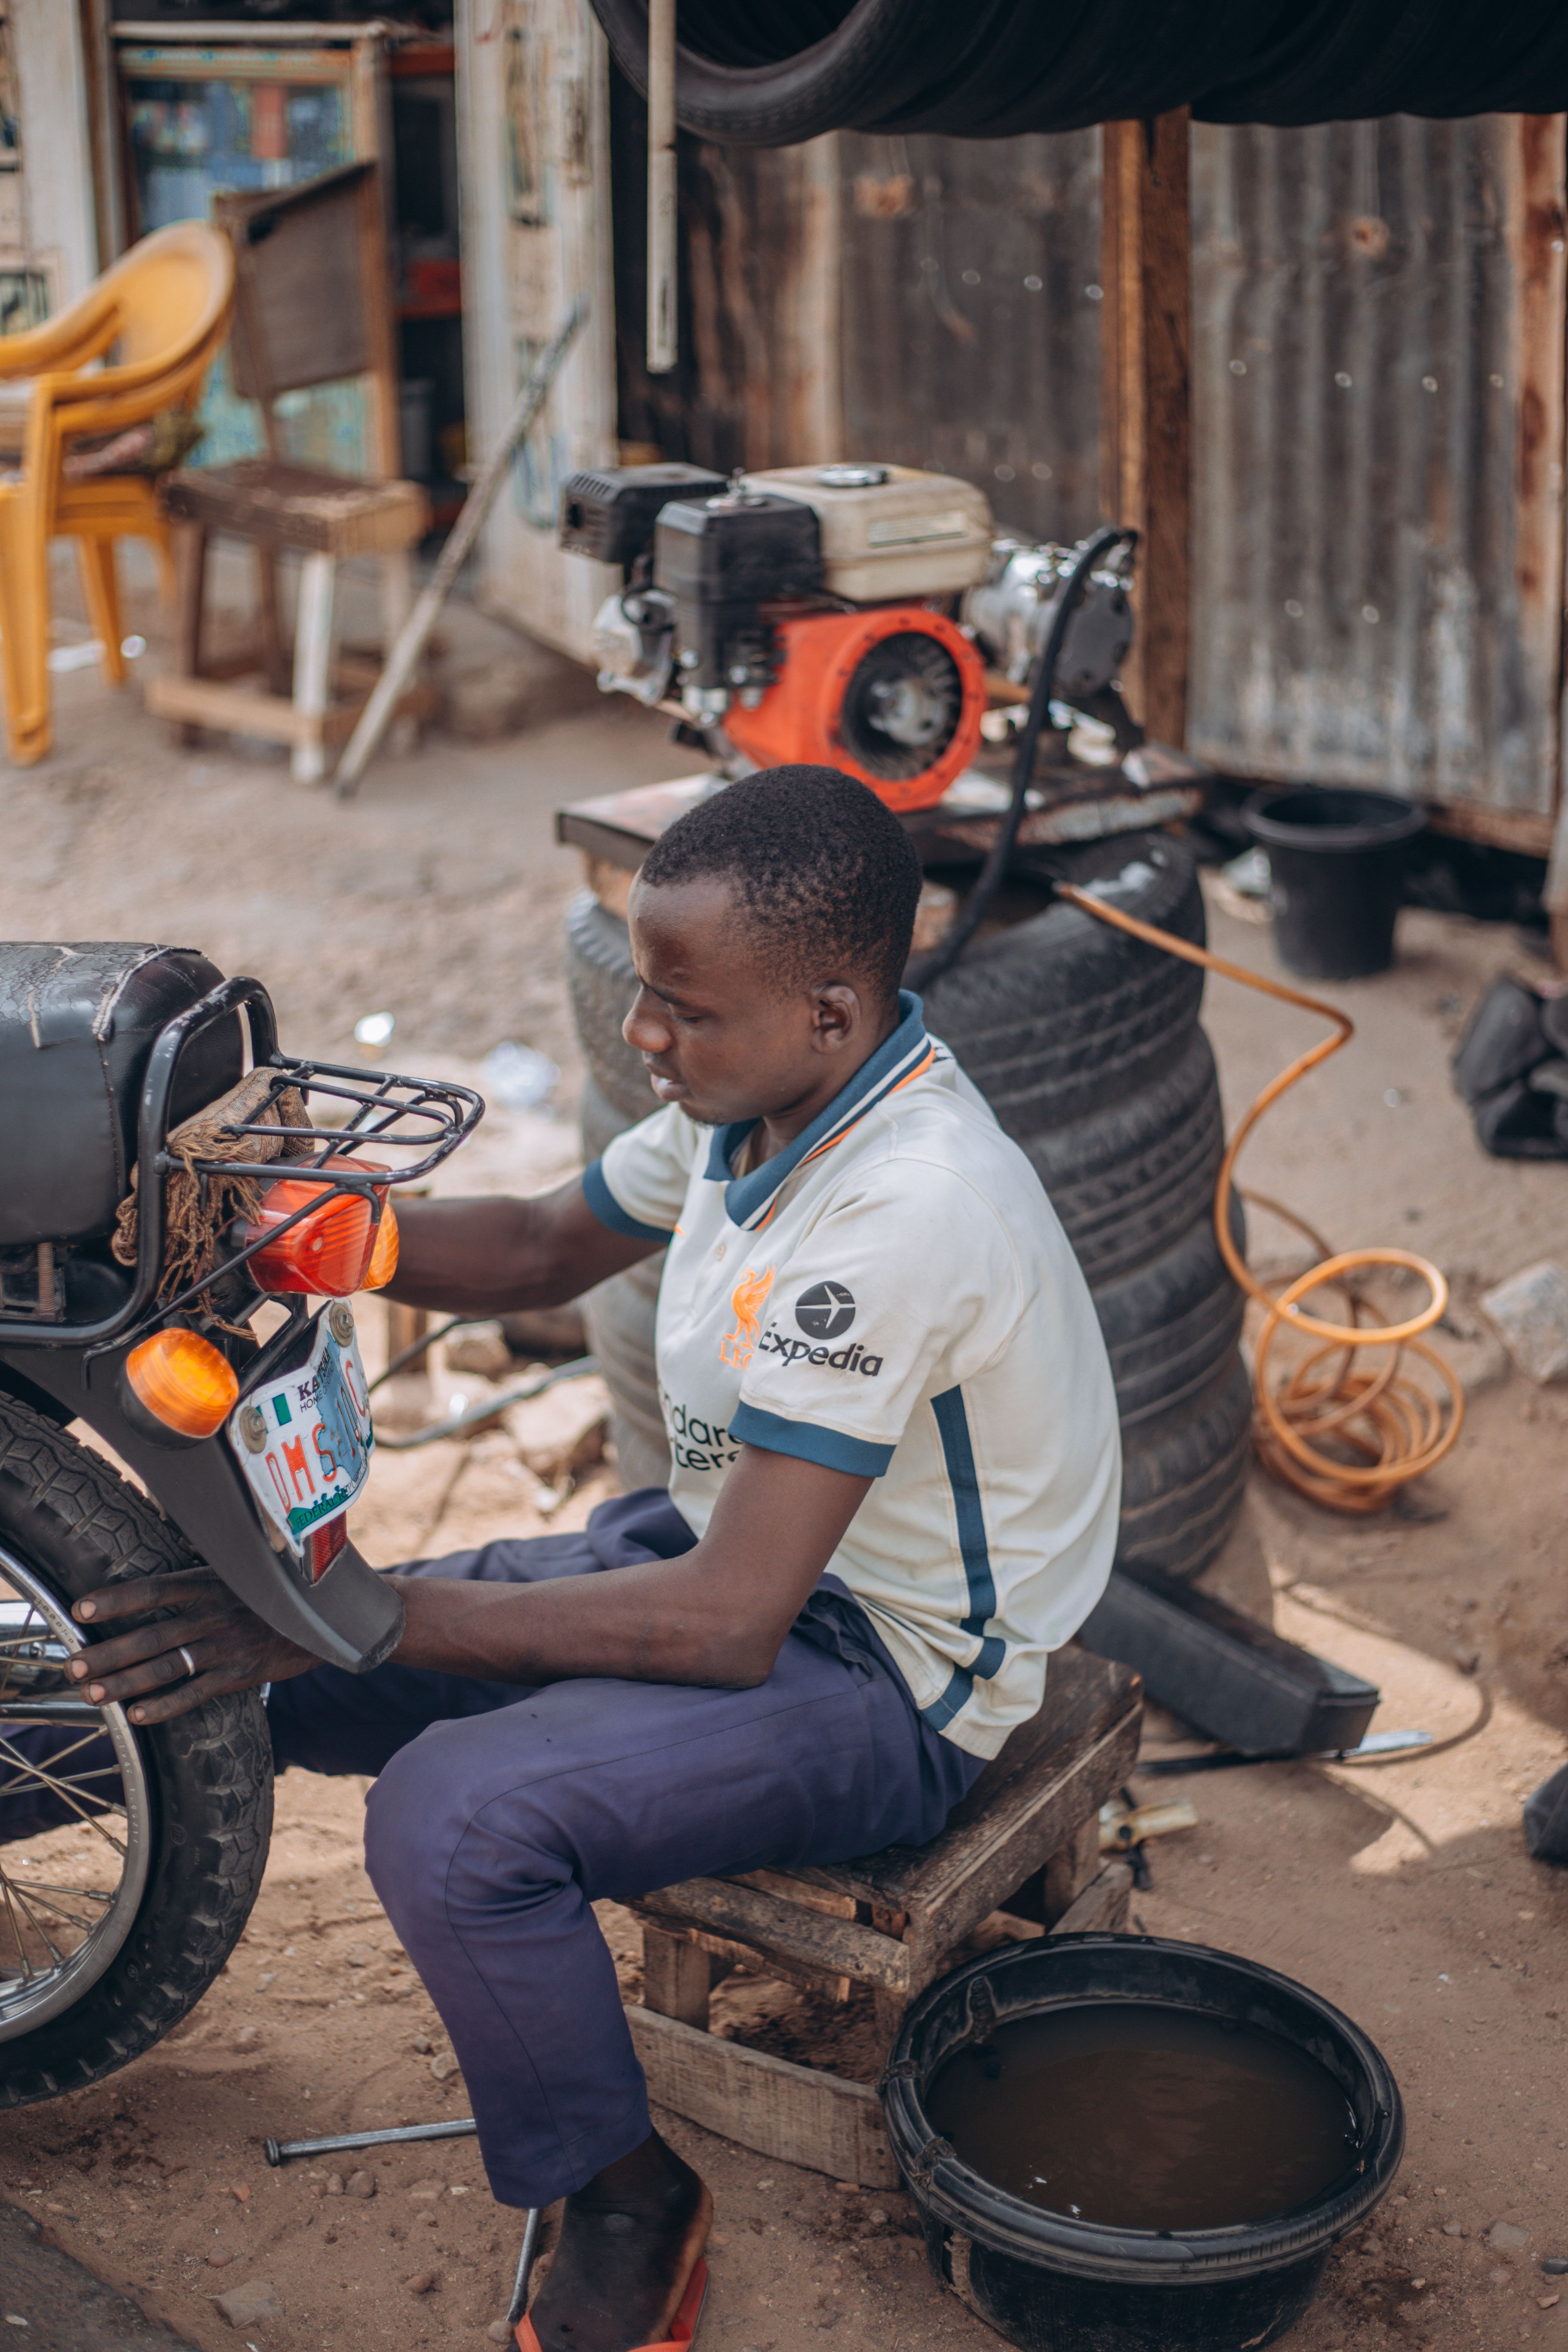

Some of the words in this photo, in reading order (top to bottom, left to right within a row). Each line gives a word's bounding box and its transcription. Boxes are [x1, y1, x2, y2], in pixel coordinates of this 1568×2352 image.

[758, 1321, 884, 1377] Expedia
[297, 1347, 331, 1401] KATSINA
[300, 1390, 323, 1413] HOME
[296, 1496, 337, 1528] FEDERAL
